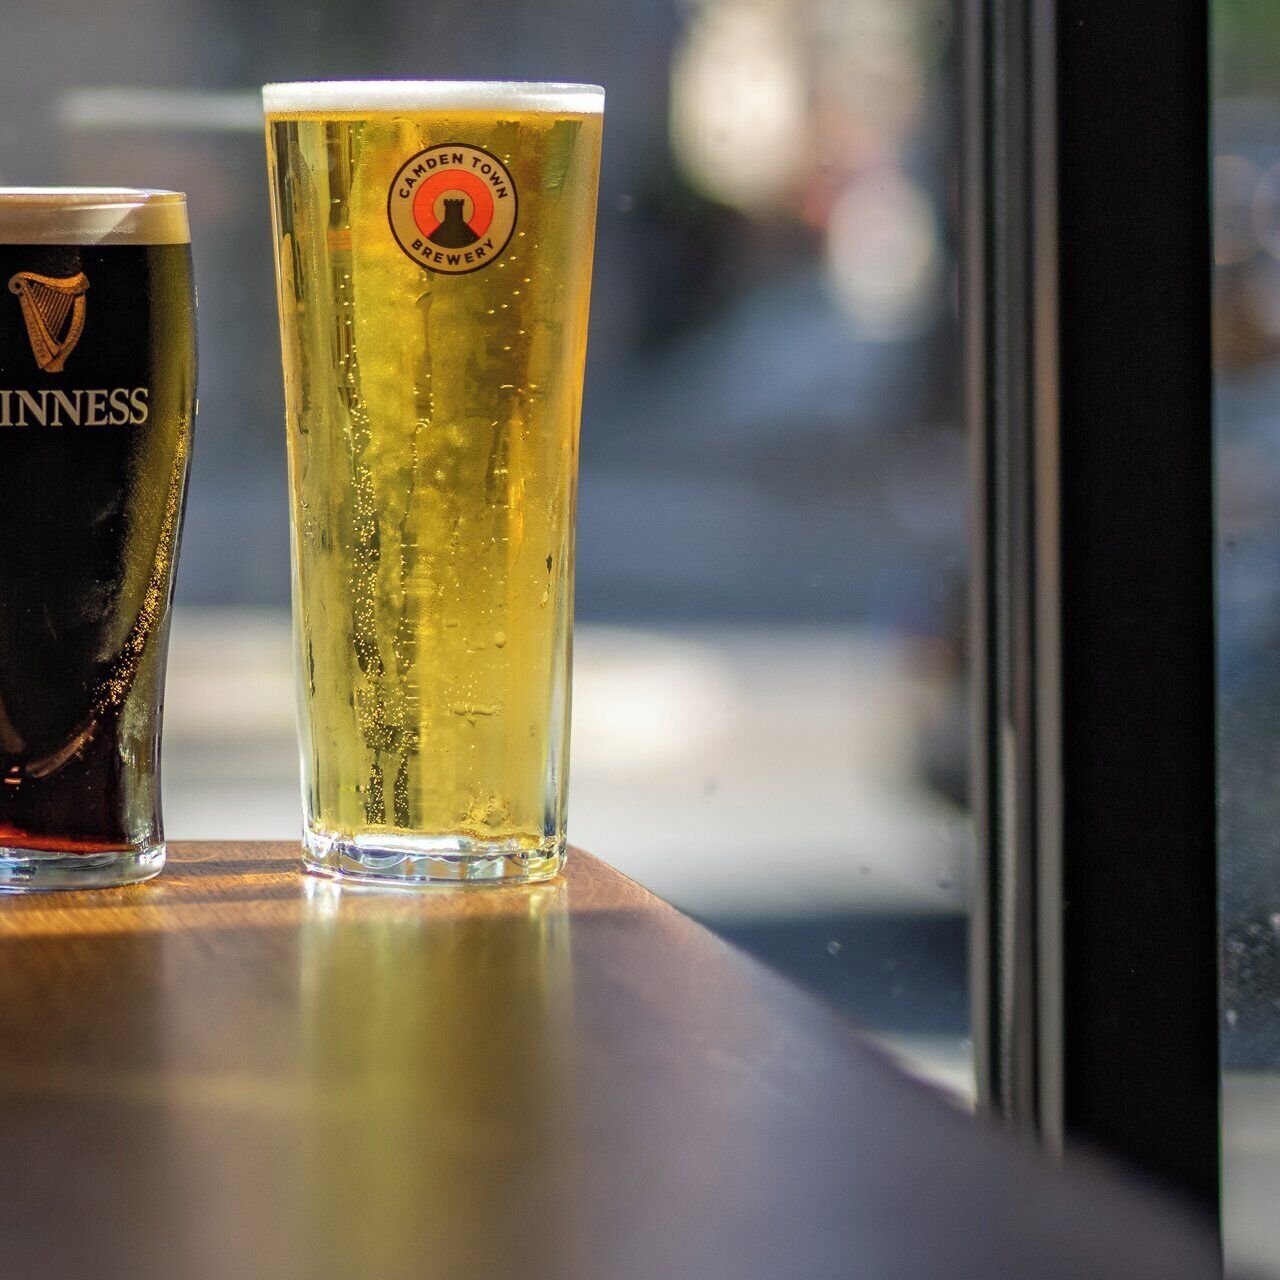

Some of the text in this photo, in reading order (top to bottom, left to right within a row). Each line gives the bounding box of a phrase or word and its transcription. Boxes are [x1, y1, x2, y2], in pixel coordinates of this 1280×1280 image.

[399, 153, 508, 199] CAMDEN TOWN
[411, 238, 494, 266] BREWERY
